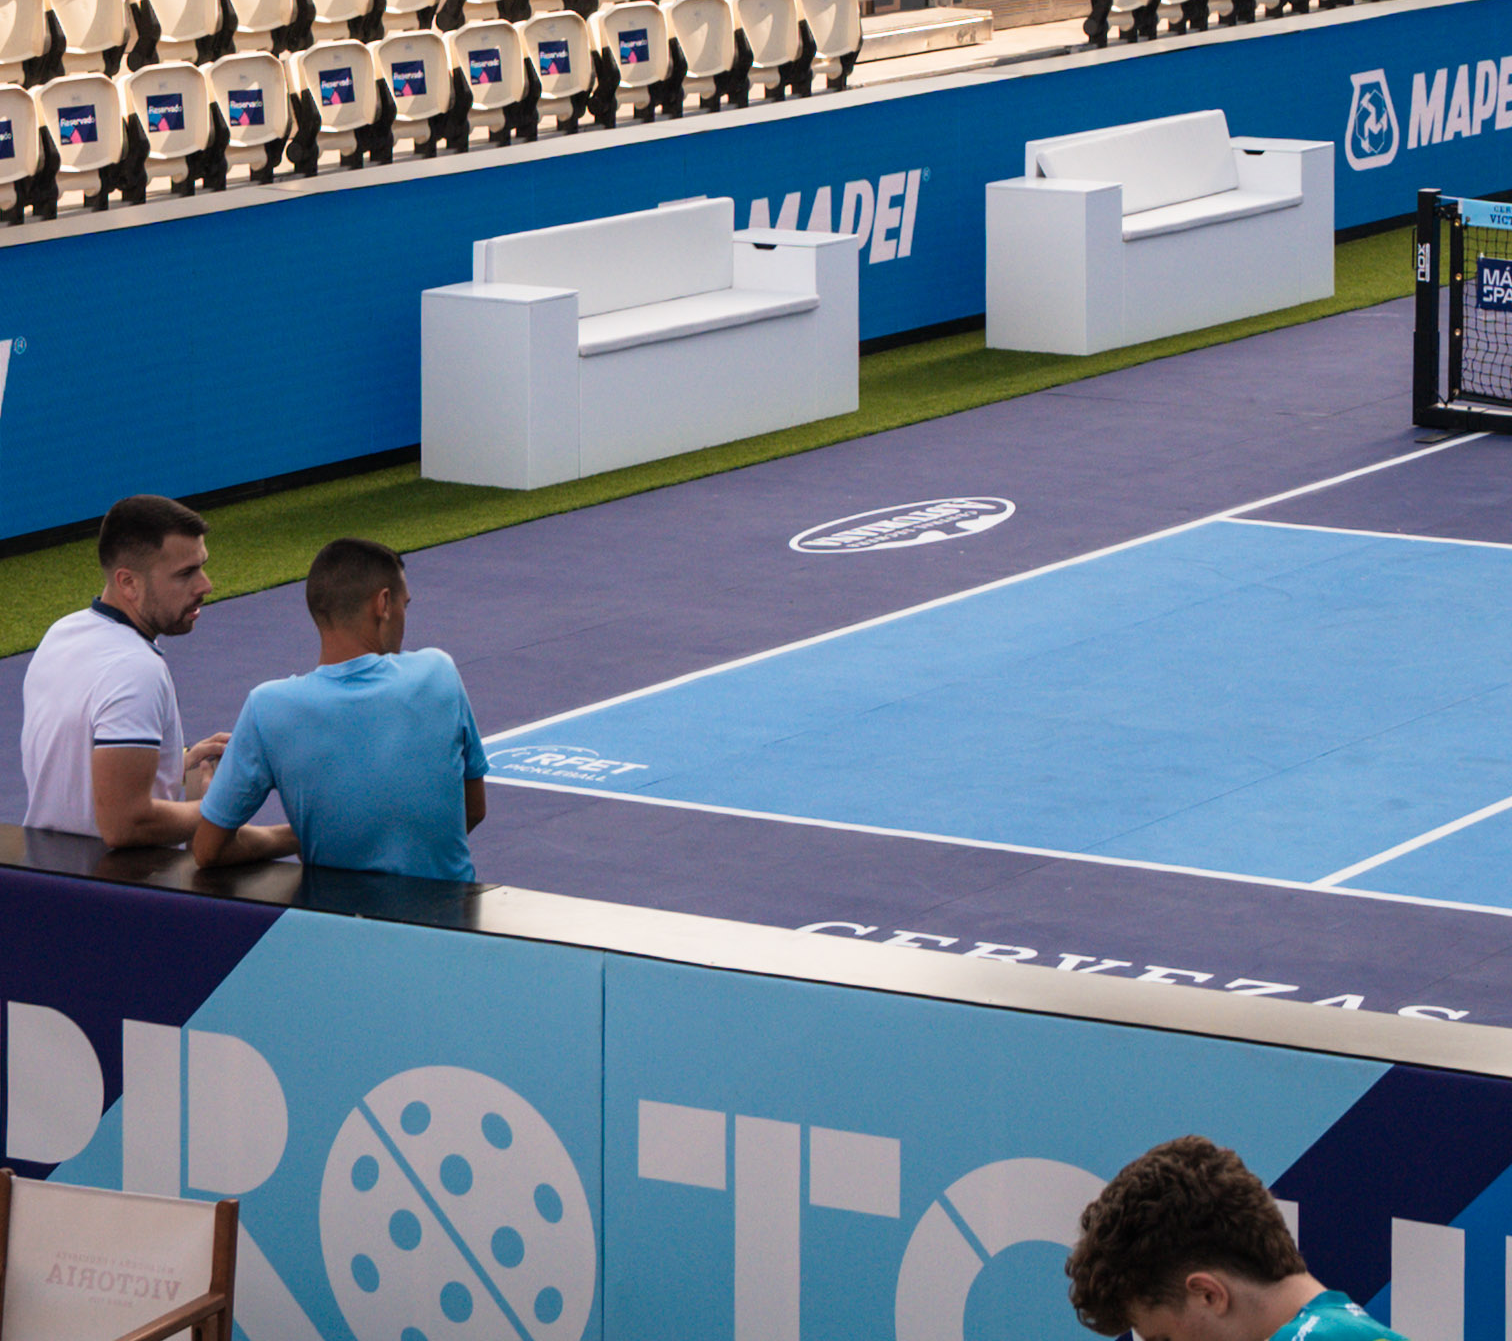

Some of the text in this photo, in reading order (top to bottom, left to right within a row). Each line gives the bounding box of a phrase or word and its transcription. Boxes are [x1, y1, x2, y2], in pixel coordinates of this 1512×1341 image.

[321, 78, 352, 89] Reservado
[148, 104, 182, 115] Reservado
[230, 99, 262, 109] Reservado
[61, 115, 95, 127] Reservado
[524, 752, 649, 774] RFET
[503, 763, 607, 783] PICKLEBALL
